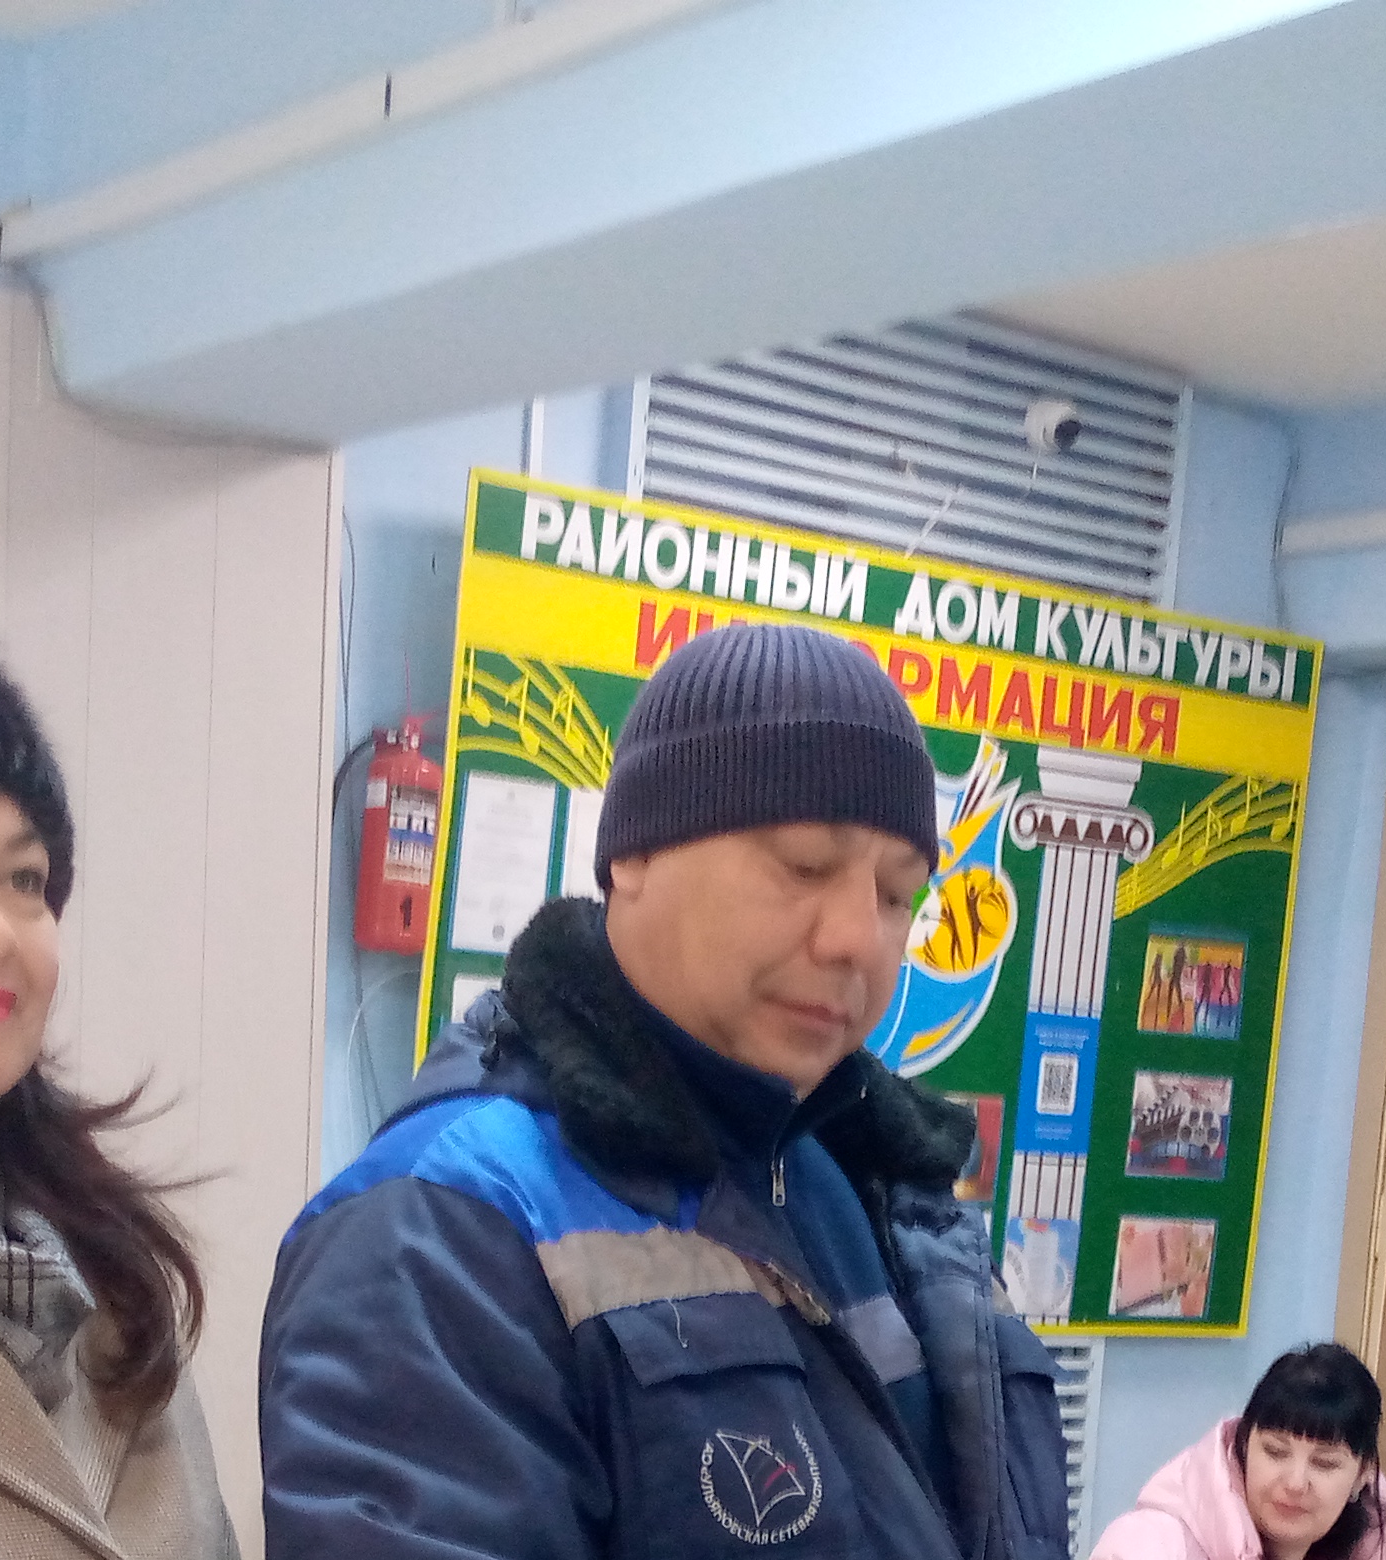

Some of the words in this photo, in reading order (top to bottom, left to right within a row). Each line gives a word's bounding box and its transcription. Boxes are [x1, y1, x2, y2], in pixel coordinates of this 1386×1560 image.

[521, 494, 869, 622] РАЙОННЫЙ
[893, 570, 1019, 648] ДОМ
[1035, 599, 1297, 703] КУЛЬТУРЫ
[634, 601, 1182, 758] ИРМАЦИЯ
